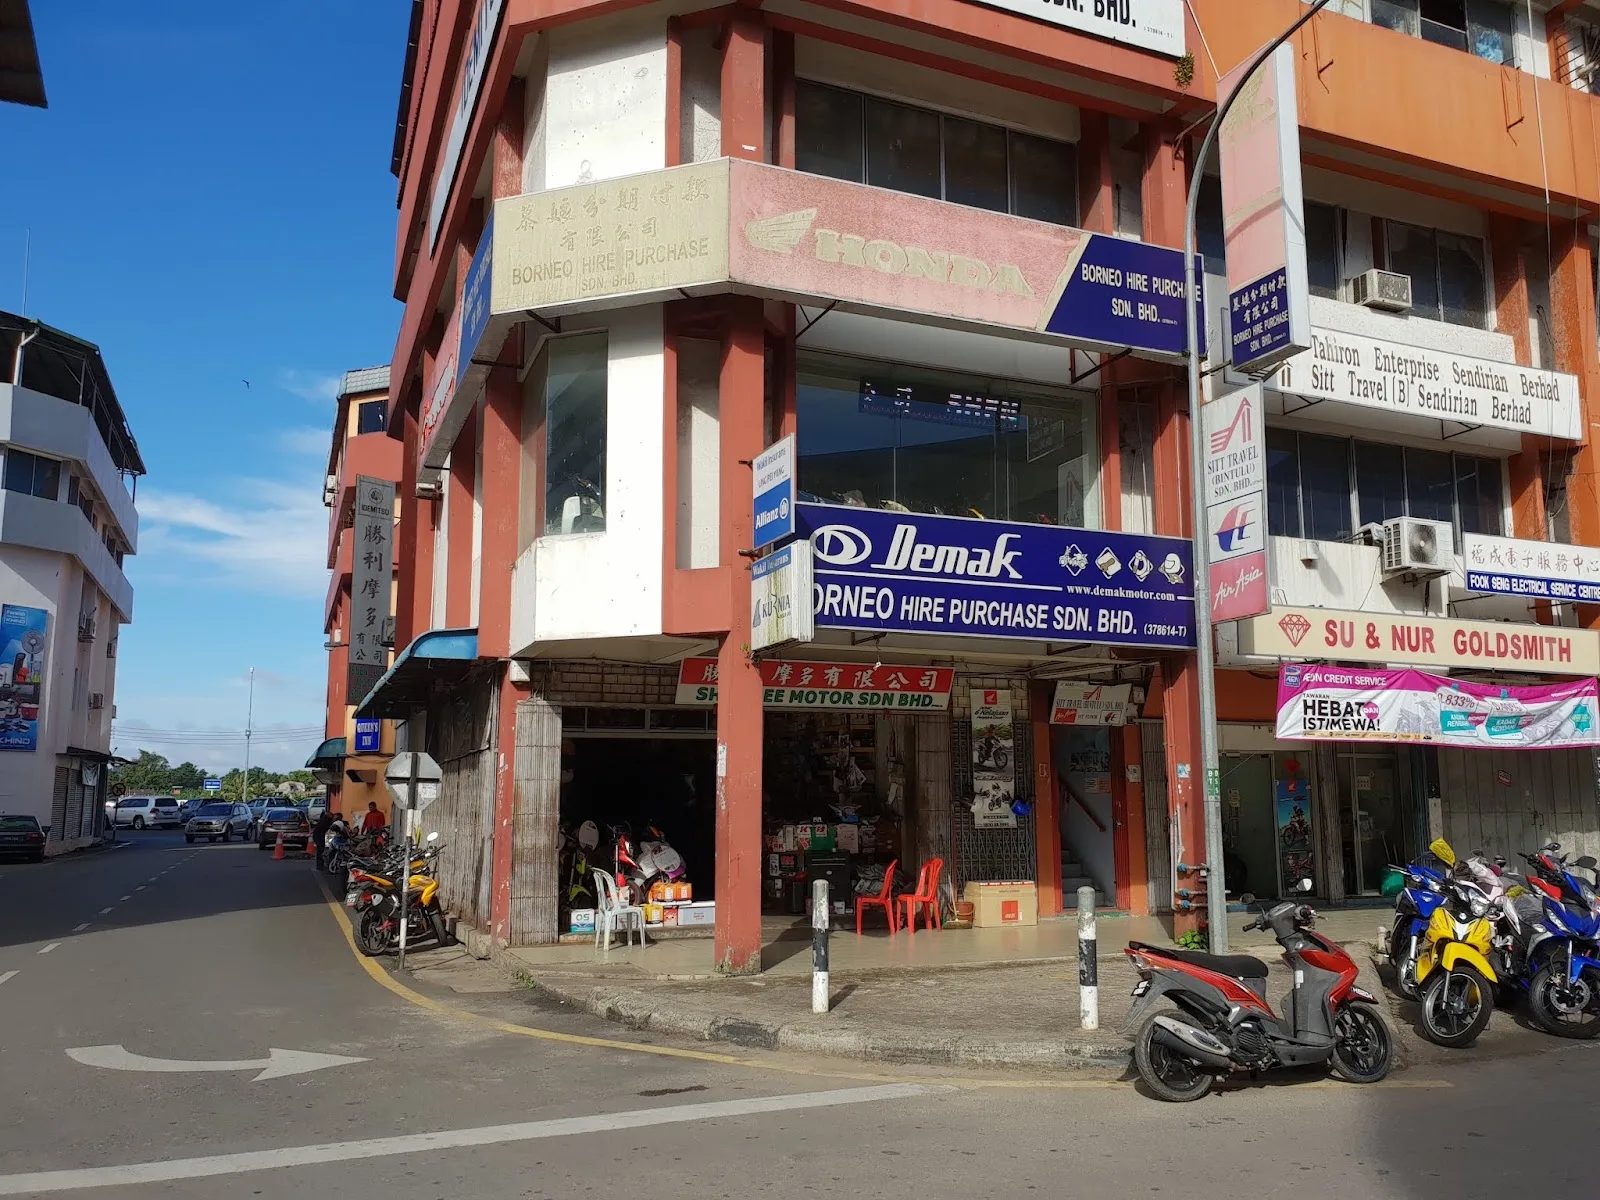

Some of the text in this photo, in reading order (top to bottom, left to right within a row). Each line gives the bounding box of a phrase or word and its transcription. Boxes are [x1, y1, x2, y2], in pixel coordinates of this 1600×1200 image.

[559, 217, 658, 251] 有限公司
[512, 237, 709, 286] BORNEO HIRE PURCHASE
[815, 229, 1035, 297] HONDA
[1081, 262, 1123, 288] BORNEO
[1126, 271, 1149, 292] HIRE
[1111, 298, 1160, 323] SDN. BHD.
[1233, 310, 1289, 345] BORNEO HIRE PURCHASE
[1311, 334, 1560, 402] Tahiron Enterprise Sendirian Berhad
[1312, 366, 1532, 425] Sitt Travel (B) Sendirian Berhad
[1208, 445, 1259, 475] SITT TRAVEL
[1211, 462, 1255, 485] (BINTULU)
[1214, 484, 1231, 498] SDN.
[1233, 478, 1252, 491] BHD.
[361, 504, 390, 517] IDEMITSU
[755, 509, 779, 529] Allianz
[870, 523, 1023, 580] Demak
[361, 523, 387, 628] 勝利摩多
[752, 562, 767, 576] Wakil
[1066, 583, 1175, 602] www.demakmotor.com
[1470, 575, 1600, 599] FOOK SENG ELECTRICAL SERVICE CENTRE
[813, 582, 1188, 637] ORNEO HIRE PURCHASE SDN. BHD. (378614-T)
[1325, 619, 1571, 663] SU & NUR GOLDSMITH
[356, 650, 383, 665] 公司
[1324, 674, 1354, 685] CREDIT
[1355, 676, 1387, 687] SERVICE
[789, 690, 853, 705] MOTOR
[858, 693, 894, 706] SDN
[899, 694, 933, 708] BHD
[1303, 699, 1365, 717] HEBAT
[357, 722, 378, 733] QUEEN'S
[1303, 717, 1381, 731] ISTIMEWA!
[362, 736, 372, 746] INN
